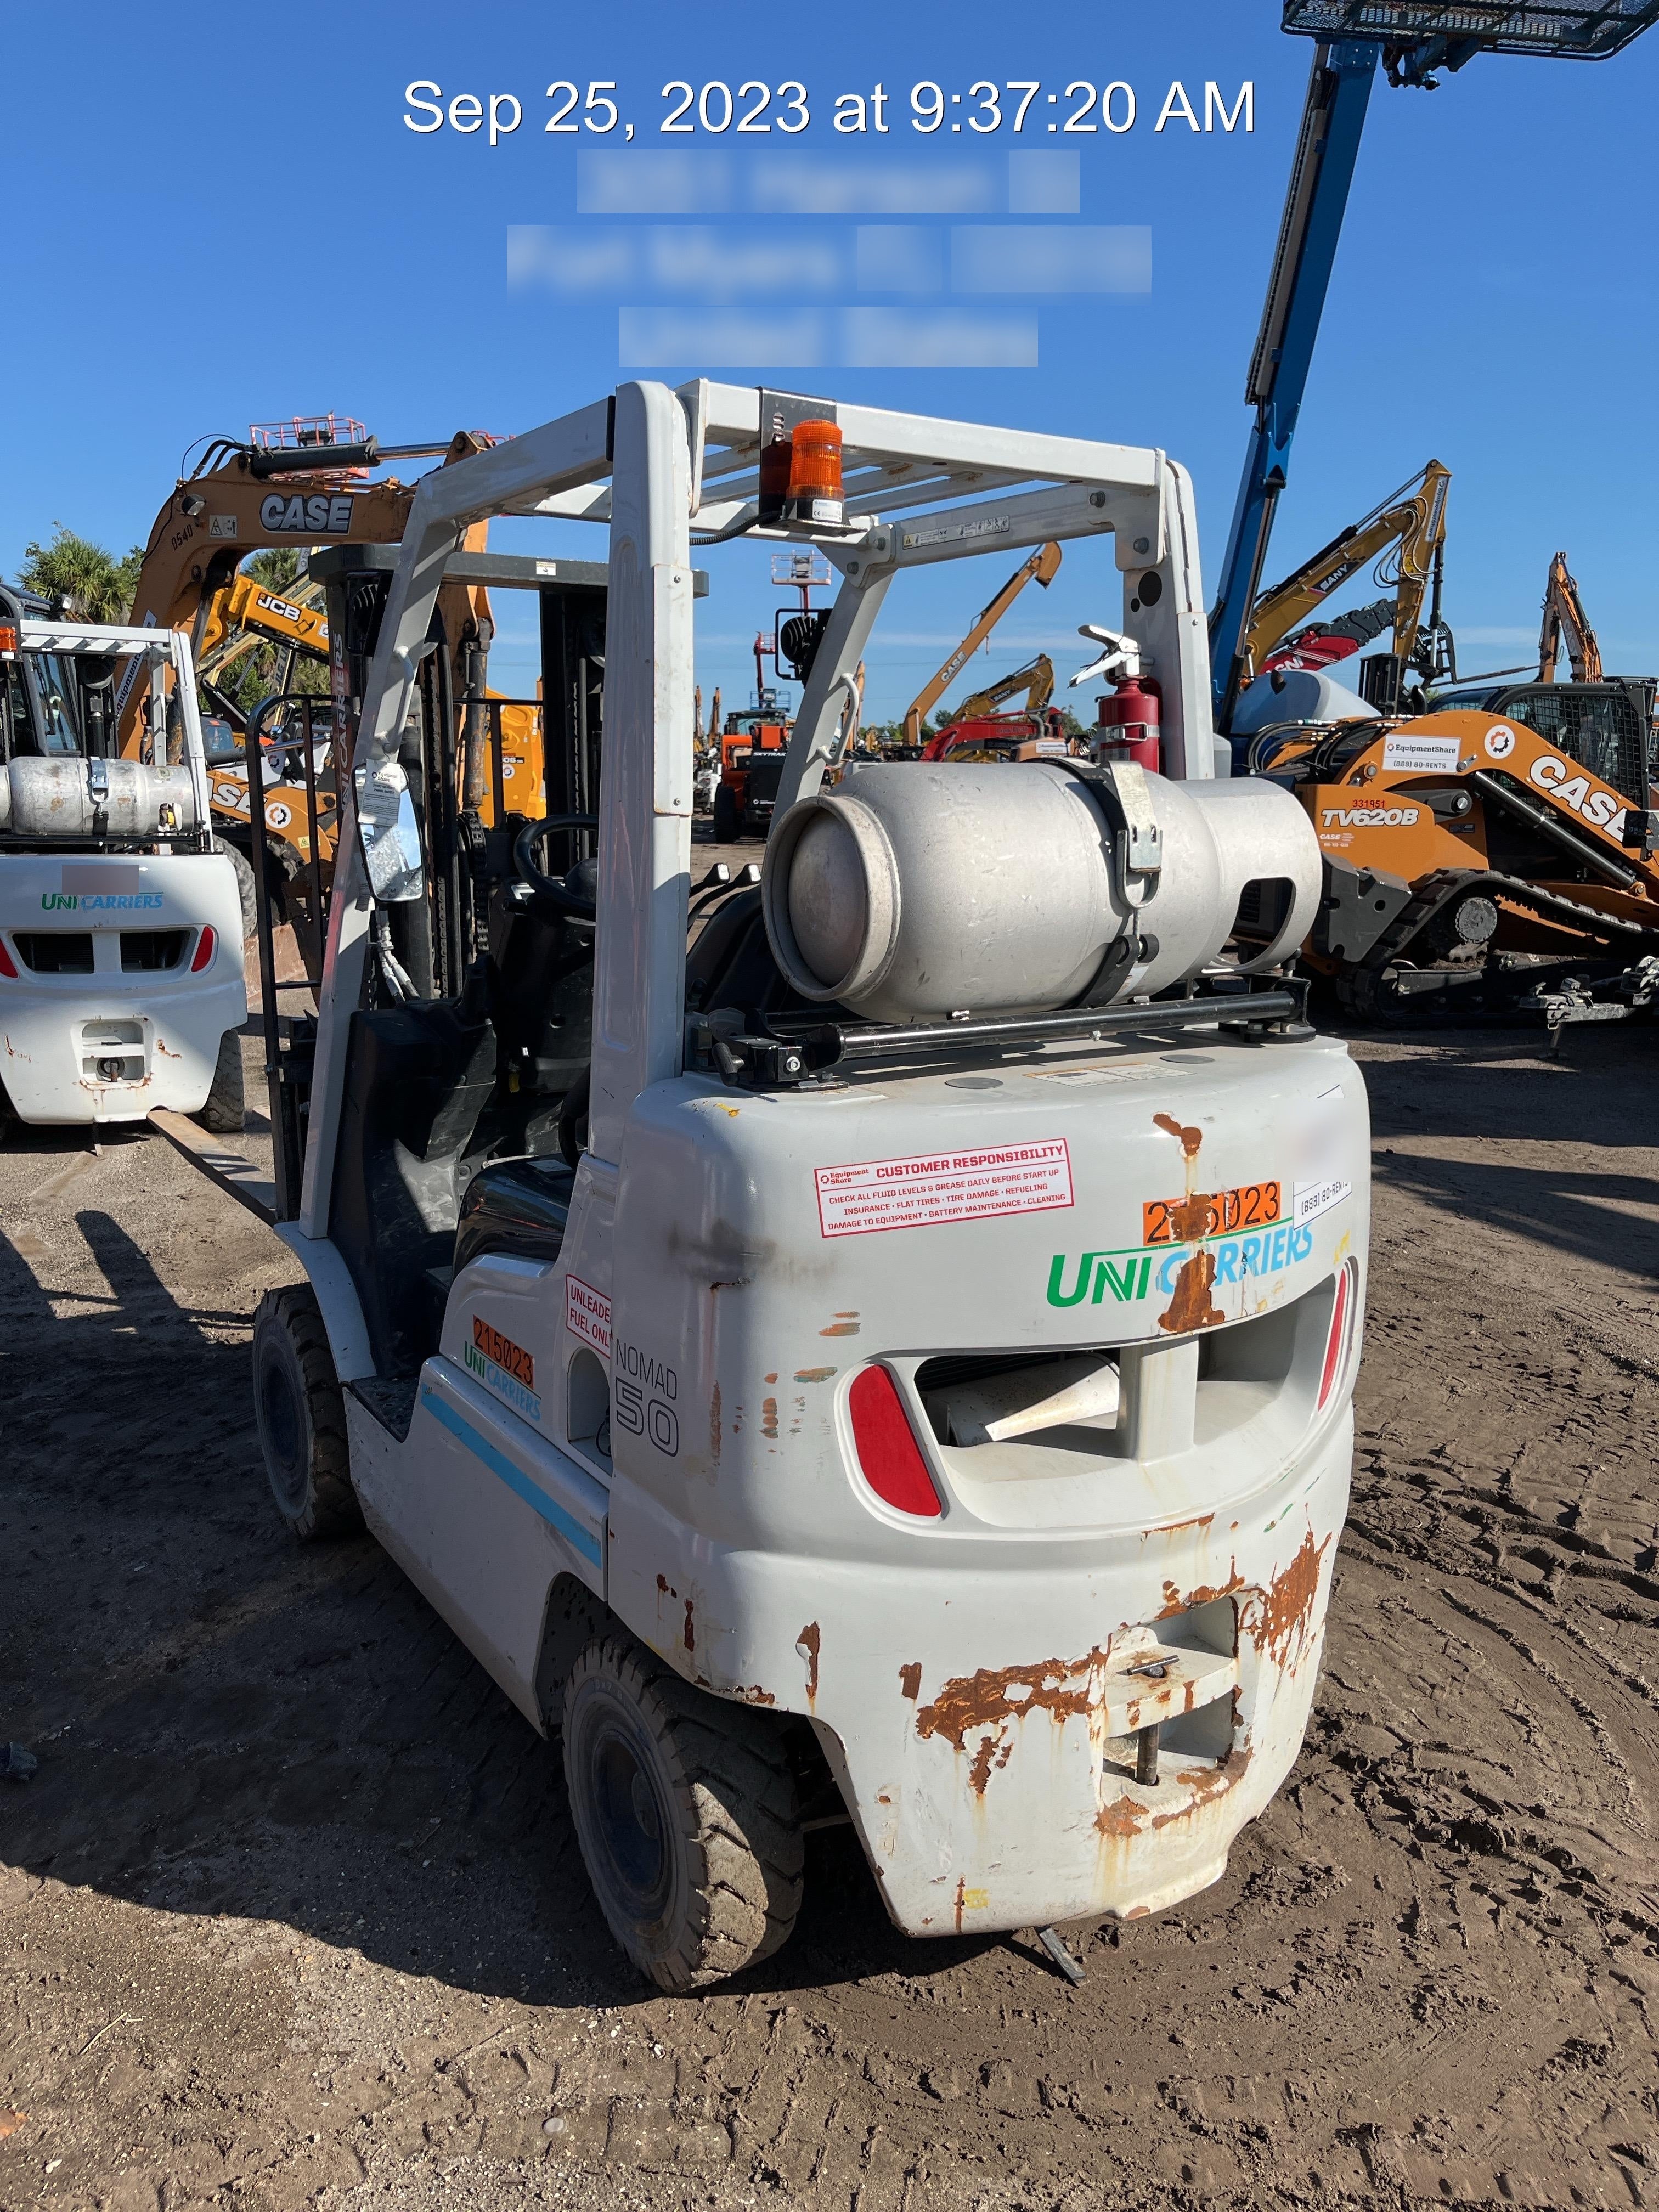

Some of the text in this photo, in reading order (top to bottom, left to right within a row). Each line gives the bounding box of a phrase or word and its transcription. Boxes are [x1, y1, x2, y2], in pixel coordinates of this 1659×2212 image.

[260, 494, 354, 532] CASE
[1319, 563, 1349, 591] SANY
[257, 594, 301, 622] JCB
[941, 651, 967, 682] CASE
[1396, 744, 1456, 754] EquipmentShare
[1322, 808, 1419, 827] TV620B
[1352, 799, 1385, 808] 331951
[830, 1169, 870, 1178] Equipment
[876, 1146, 1063, 1179] CUSTOMER RESPONSIBILITY
[829, 1194, 856, 1204] CHECK
[857, 1191, 871, 1201] ALL
[873, 1189, 896, 1199] FLUID
[898, 1186, 926, 1197] LEVELS
[928, 1184, 934, 1192] &
[935, 1181, 966, 1192] GREASE
[968, 1178, 990, 1188] DAILY
[992, 1175, 1022, 1184] BEFORE
[1023, 1171, 1047, 1181] START
[831, 1177, 852, 1185] Share
[828, 1220, 861, 1230] DAMAGE
[876, 1212, 922, 1224] EQUIPMENT
[929, 1207, 963, 1218] BATTERY
[964, 1199, 1022, 1213] MAINTENANCE
[1028, 1194, 1065, 1205] CLEANING
[844, 1183, 1048, 1215] INSURANCE FLAT TIRES TIRE DAMAGE REFUELING
[571, 1284, 611, 1324] UNLEADE
[570, 1307, 610, 1348] FUEL ONL
[616, 1338, 678, 1401] NOMAD
[616, 1376, 679, 1458] 50
